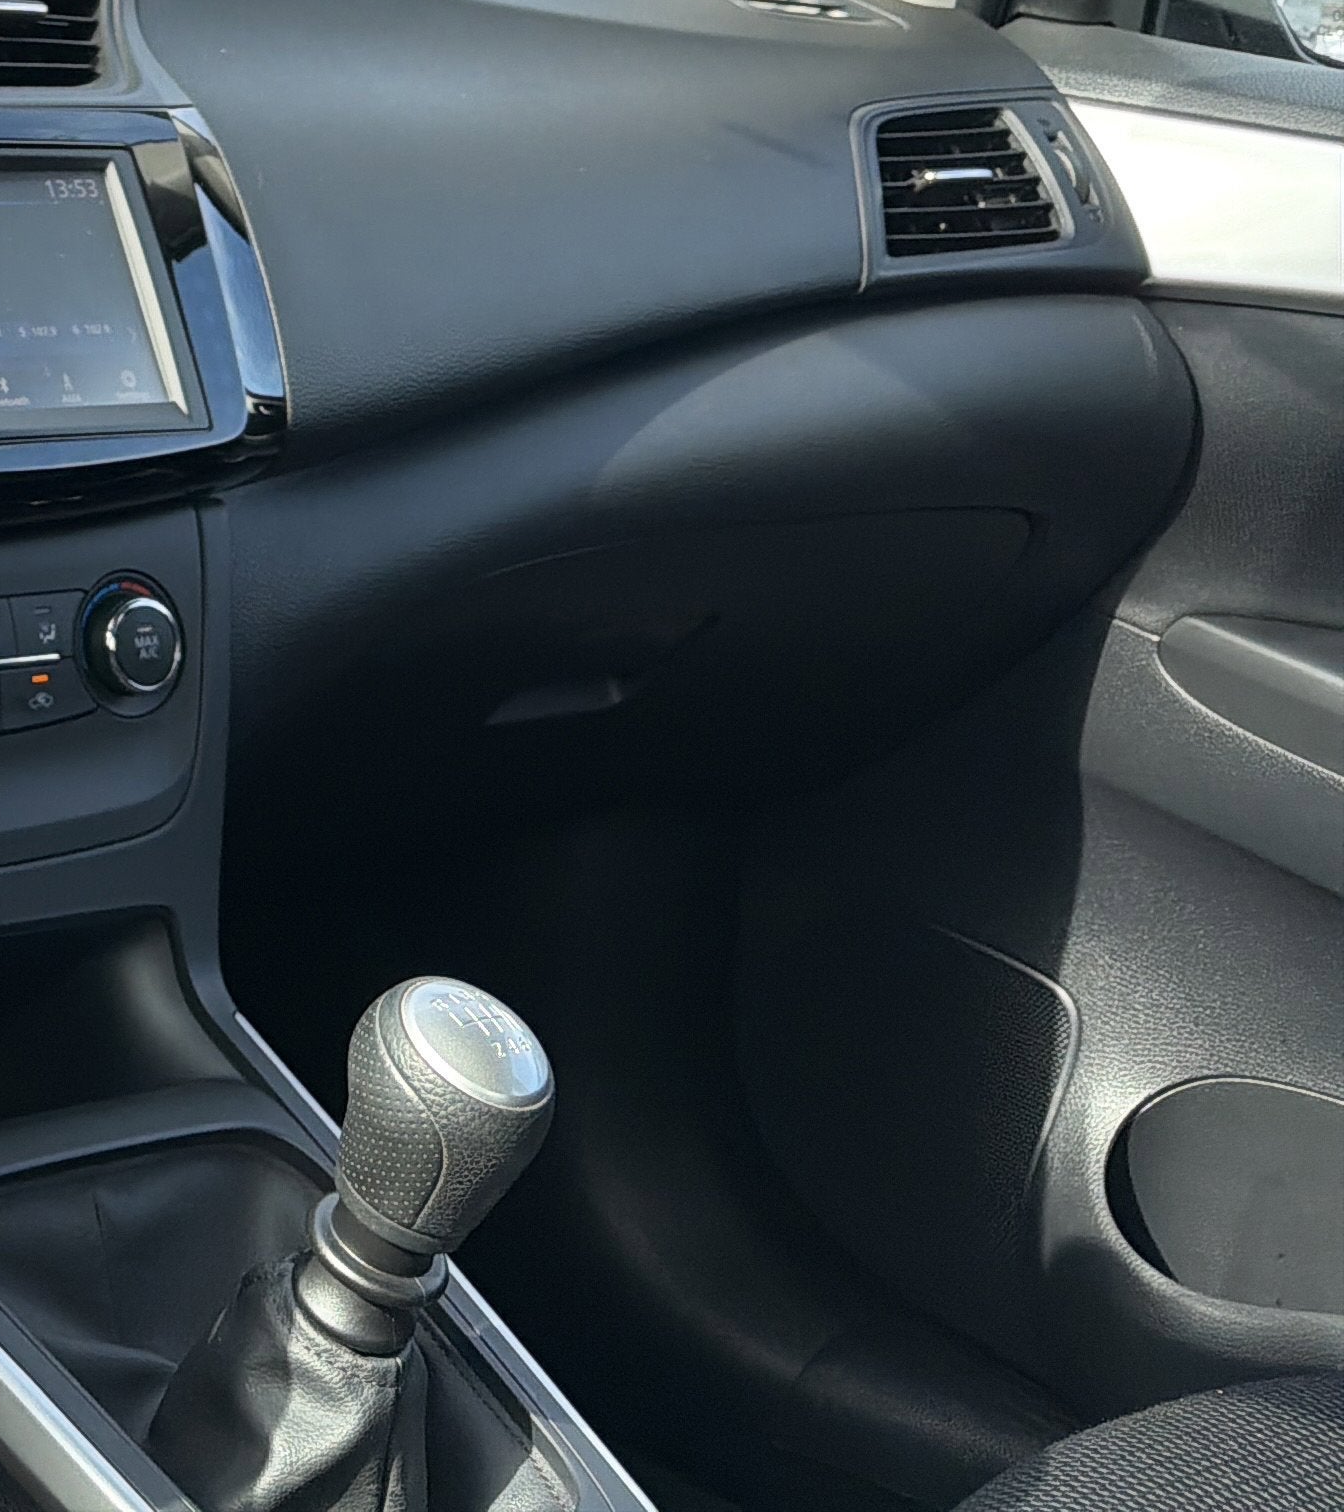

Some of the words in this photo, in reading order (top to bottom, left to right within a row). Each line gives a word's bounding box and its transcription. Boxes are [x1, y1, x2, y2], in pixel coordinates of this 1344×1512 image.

[44, 178, 99, 199] 13:53
[134, 635, 160, 648] MAX
[139, 646, 159, 660] A/C
